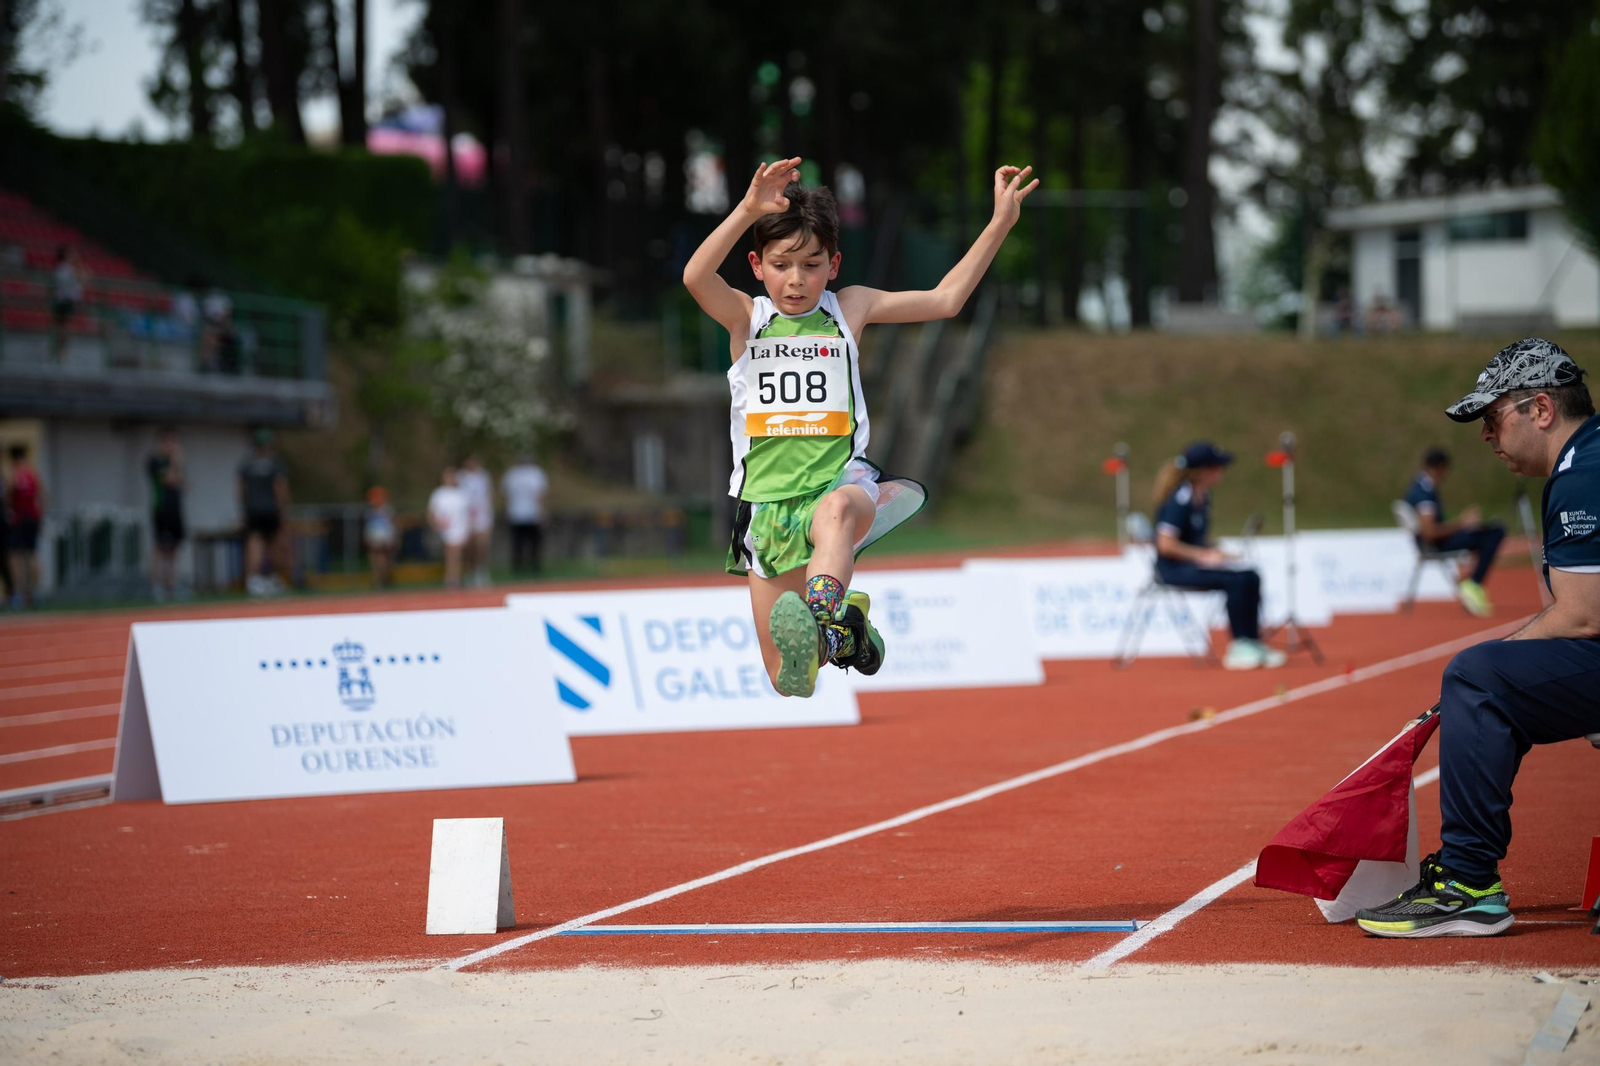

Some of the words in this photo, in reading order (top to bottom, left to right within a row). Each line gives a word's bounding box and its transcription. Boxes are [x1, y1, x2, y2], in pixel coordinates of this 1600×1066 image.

[749, 345, 771, 360] La
[758, 371, 827, 404] 508
[765, 424, 828, 436] telemiño
[643, 616, 758, 653] DEPO
[269, 713, 457, 748] DEPUTACIÓN
[301, 745, 437, 774] OURENSE
